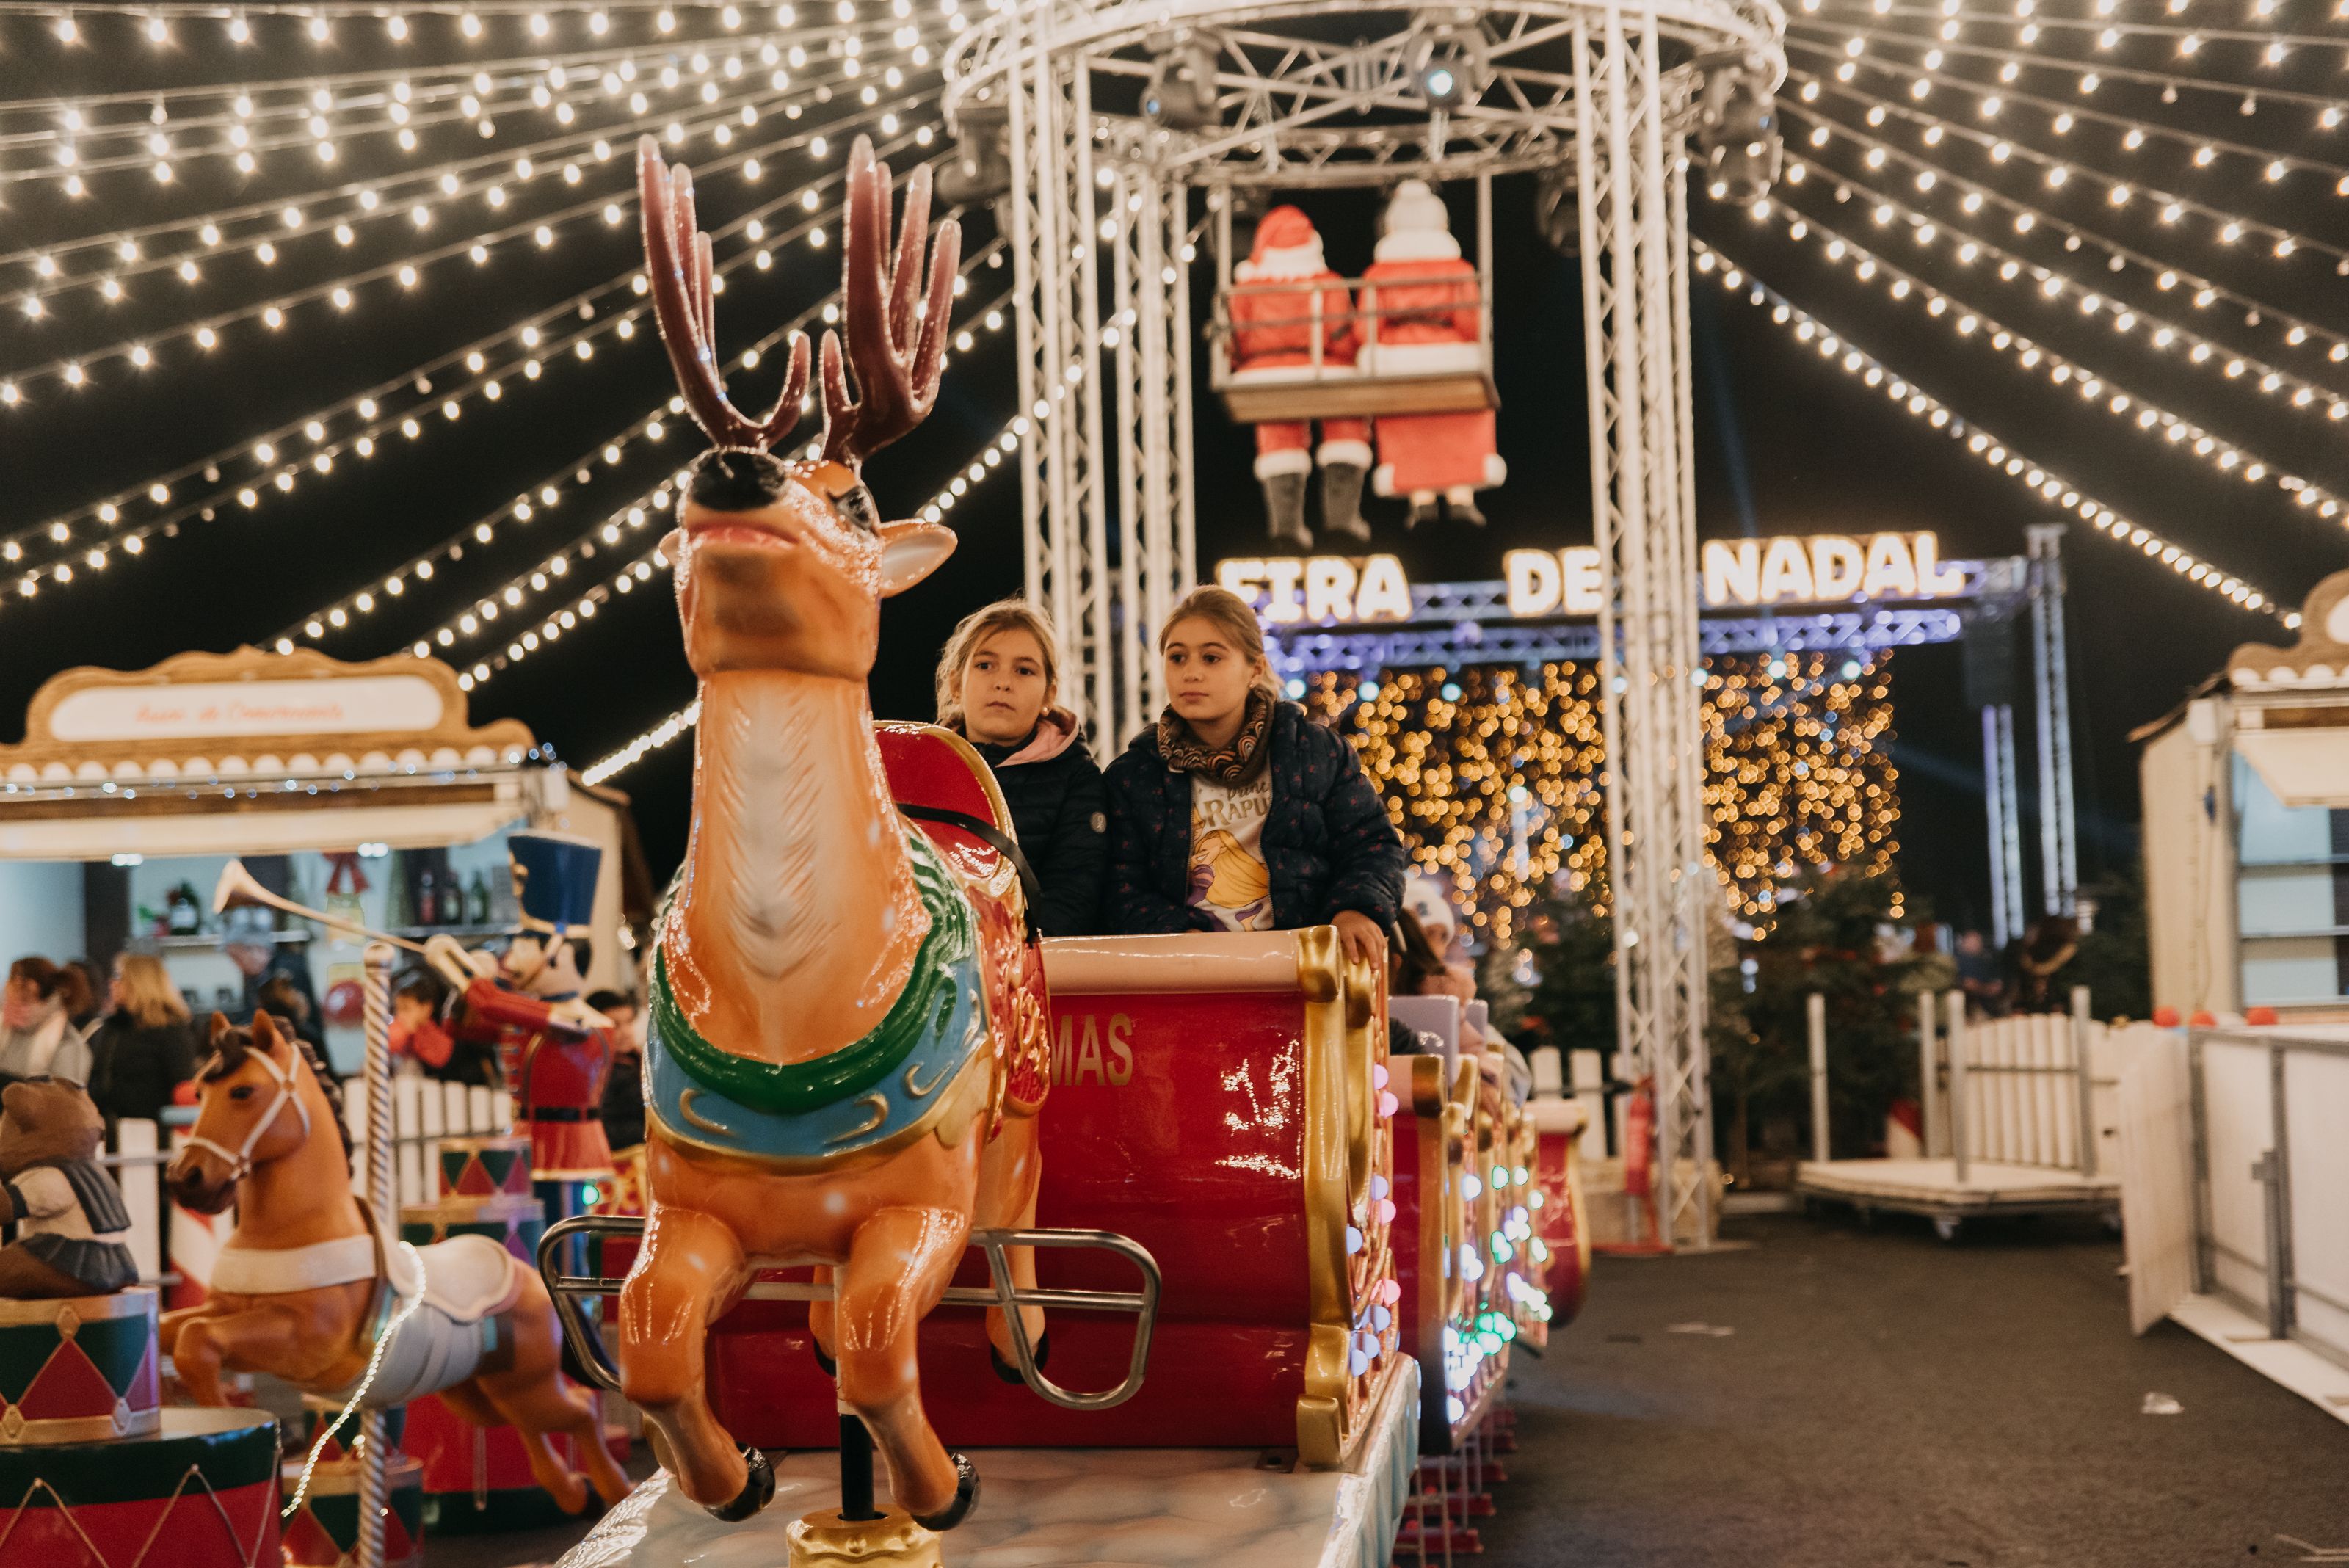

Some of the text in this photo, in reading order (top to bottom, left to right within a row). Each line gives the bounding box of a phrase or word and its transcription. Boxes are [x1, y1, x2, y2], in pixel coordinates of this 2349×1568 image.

[1504, 546, 1603, 618] DE
[1702, 530, 1965, 606] NADAL
[1050, 1013, 1133, 1086] MAS
